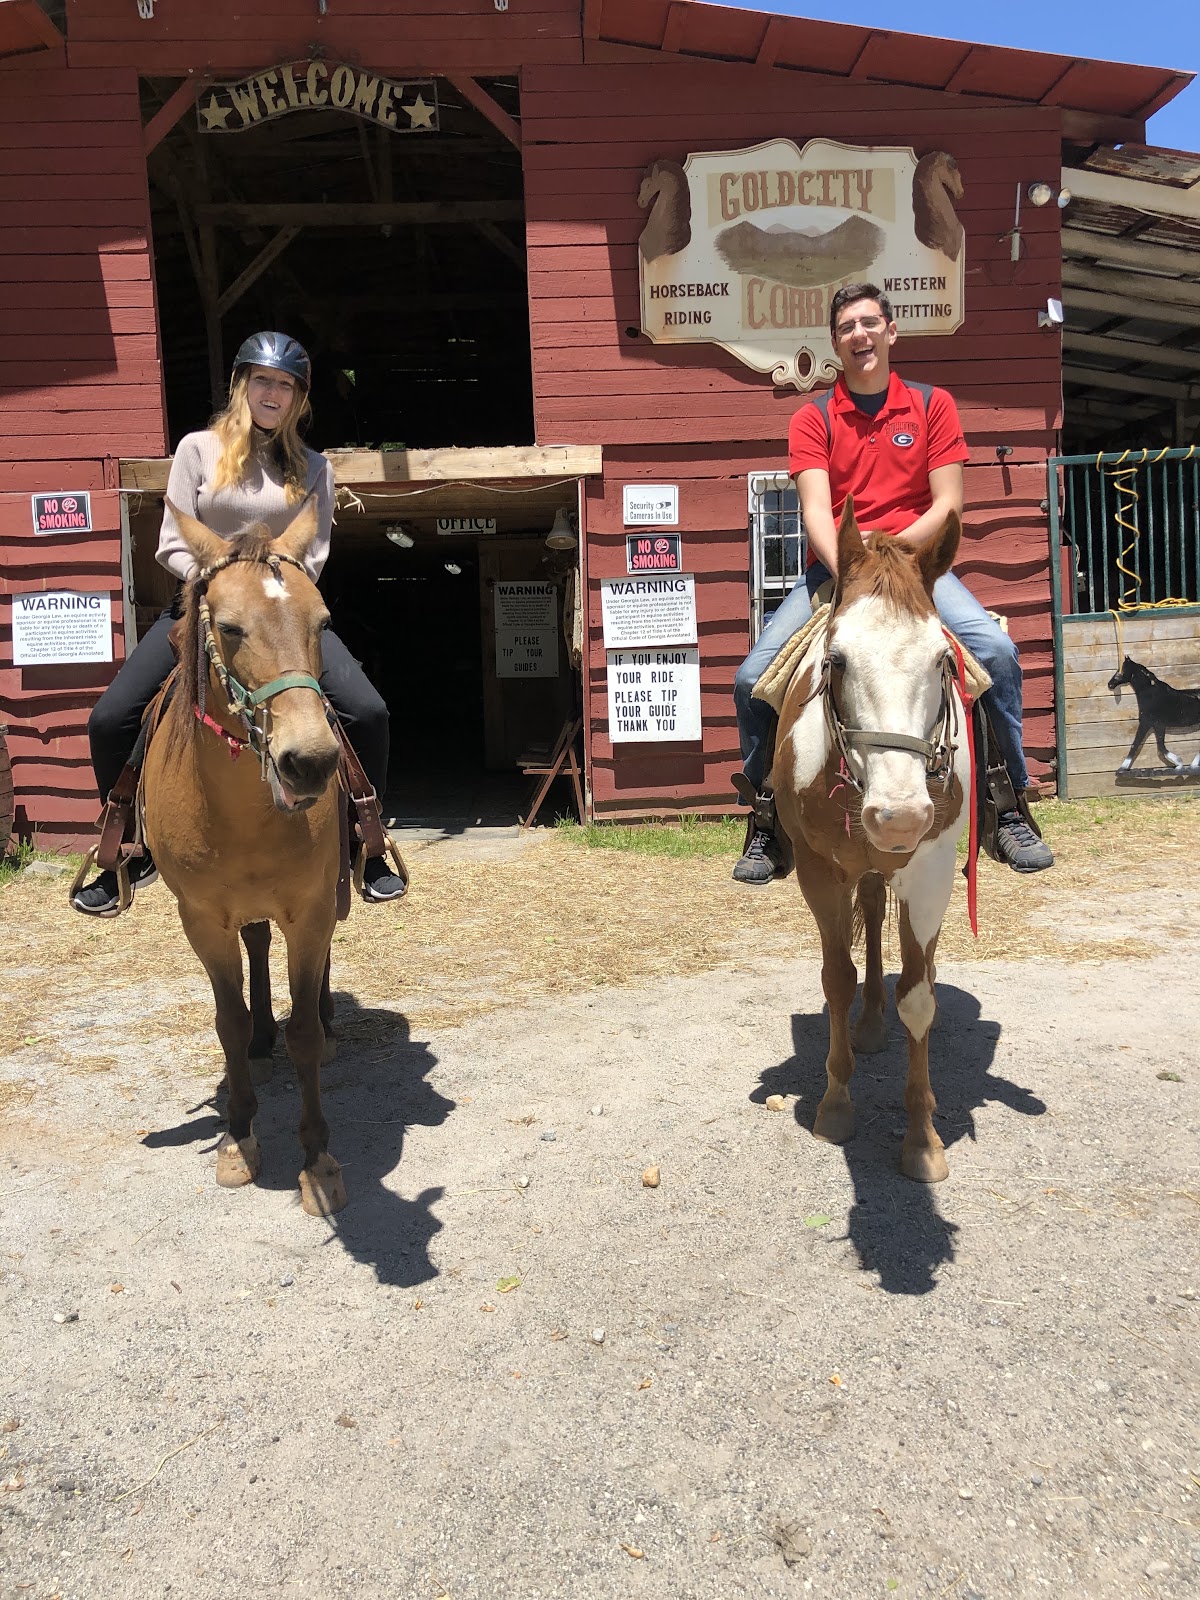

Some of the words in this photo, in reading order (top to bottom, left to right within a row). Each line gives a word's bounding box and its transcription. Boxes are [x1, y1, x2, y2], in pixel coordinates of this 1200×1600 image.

[226, 62, 404, 125] WELCOME
[650, 282, 729, 299] HORSEBACK
[884, 277, 946, 291] WESTERN
[747, 277, 848, 329] CORR
[665, 310, 712, 325] RIDING
[892, 304, 952, 318] TFITTING
[44, 500, 58, 513] NO
[630, 502, 654, 510] Security
[40, 512, 86, 529] SMOKING
[438, 518, 494, 530] OFFICE
[638, 540, 651, 554] NO
[633, 554, 676, 568] SMOKING
[498, 586, 553, 595] WARNING
[610, 580, 686, 595] WARNING
[21, 596, 101, 611] WARNING
[515, 637, 540, 645] PLEASE
[526, 648, 543, 658] YOUR
[615, 655, 623, 666] IF
[632, 654, 650, 665] YOU
[657, 653, 686, 664] ENJOY
[514, 663, 537, 672] GUIDES
[617, 672, 641, 684] YOUR
[652, 672, 674, 683] RIDE
[615, 691, 652, 703] PLEASE
[662, 690, 678, 702] TIP
[616, 706, 640, 718] YOUR
[649, 705, 676, 716] GUIDE
[618, 720, 648, 732] THANK
[656, 719, 675, 731] YOU
